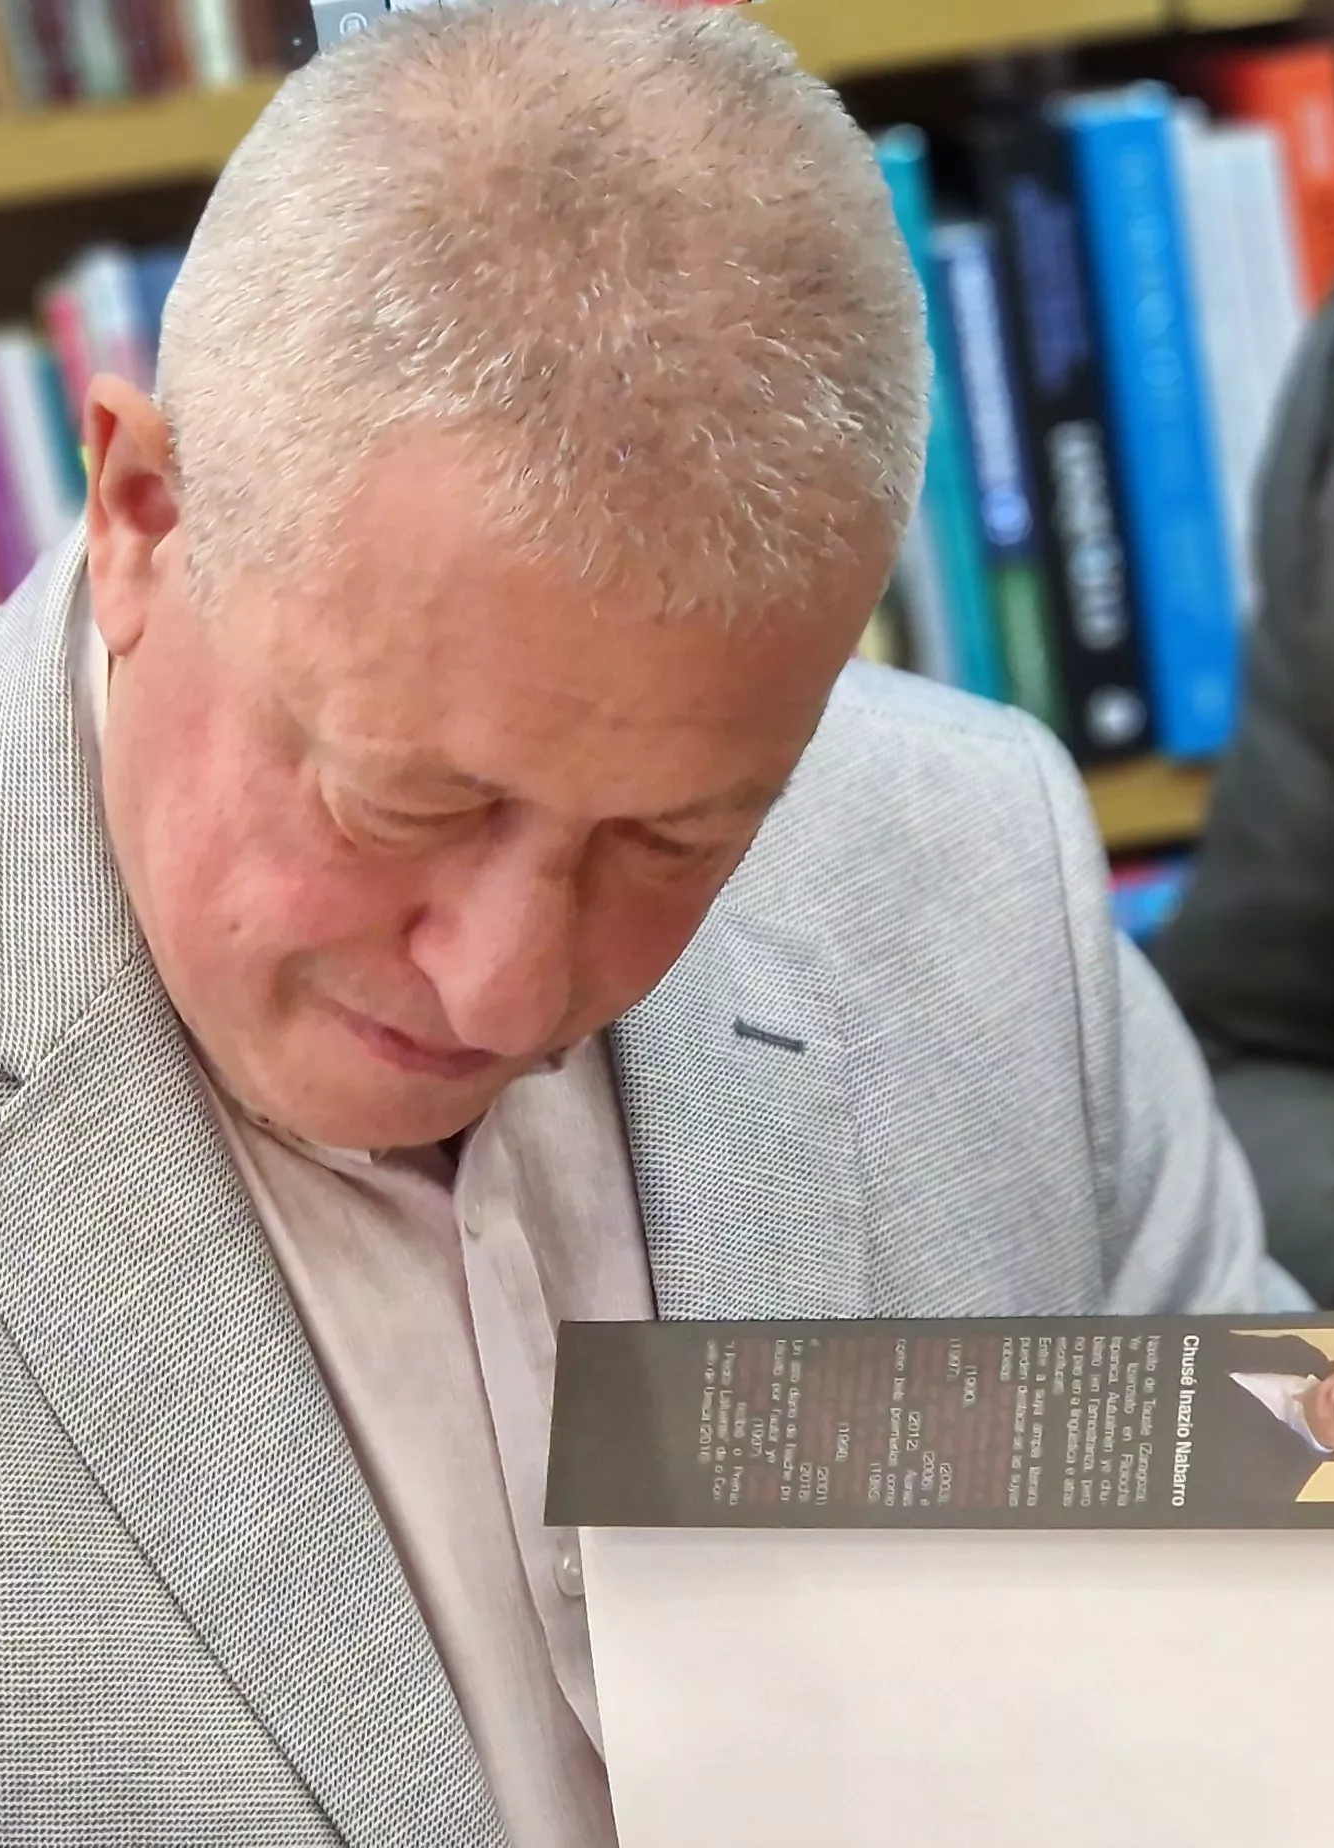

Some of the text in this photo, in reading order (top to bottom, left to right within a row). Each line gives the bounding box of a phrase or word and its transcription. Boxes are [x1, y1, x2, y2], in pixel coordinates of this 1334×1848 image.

[1122, 1425, 1133, 1441] en
[1171, 1334, 1200, 1507] Chusé Inazio Nabarro
